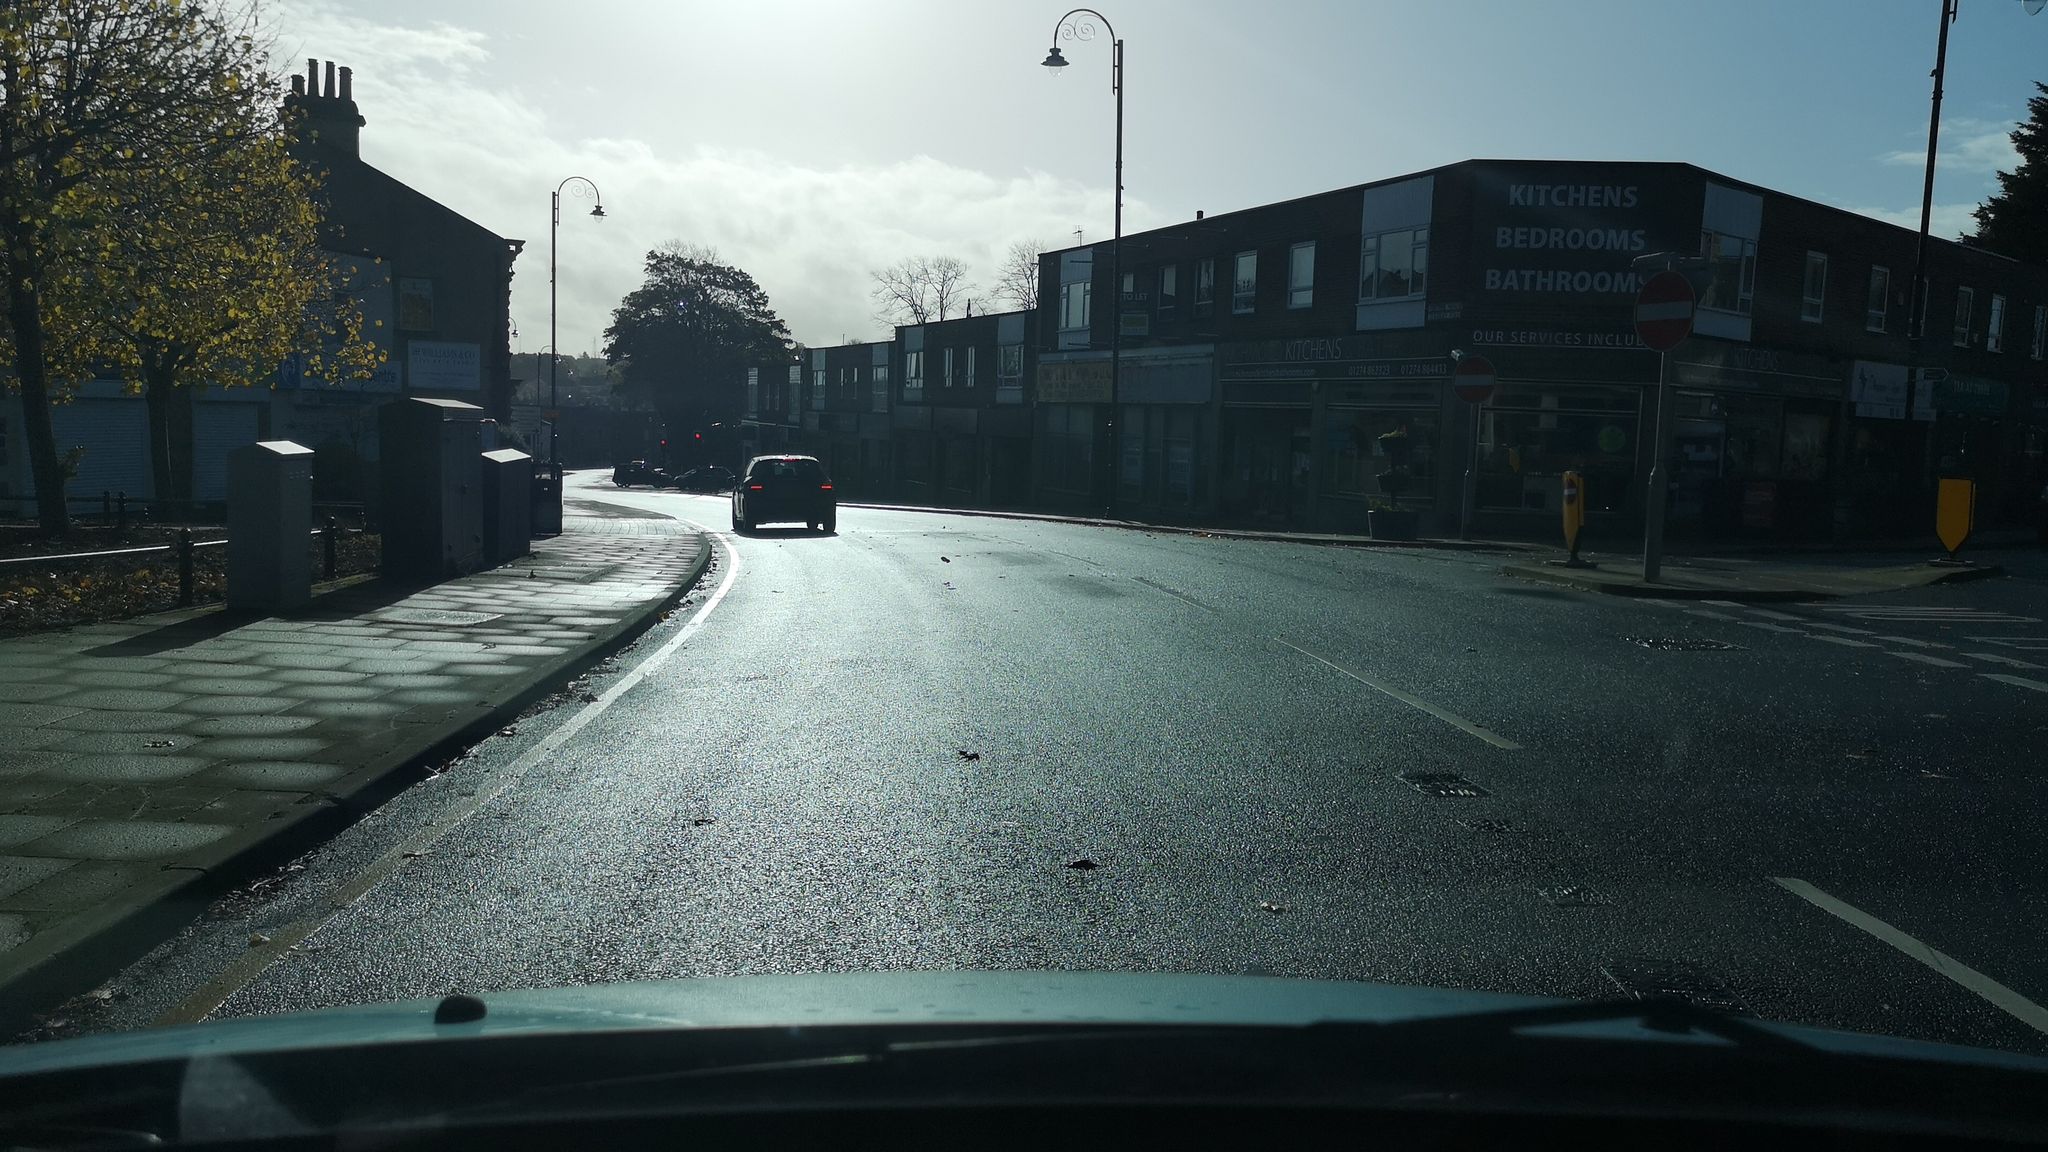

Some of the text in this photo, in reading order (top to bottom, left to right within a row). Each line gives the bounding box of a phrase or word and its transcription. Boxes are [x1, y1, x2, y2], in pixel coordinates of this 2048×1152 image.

[1509, 184, 1639, 208] KITCHENS
[1496, 226, 1646, 251] BEDROOMS
[1135, 292, 1149, 302] LET
[1285, 337, 1344, 361] KITCHENS
[1473, 330, 1504, 343] OUR
[1511, 330, 1582, 345] SERVICES
